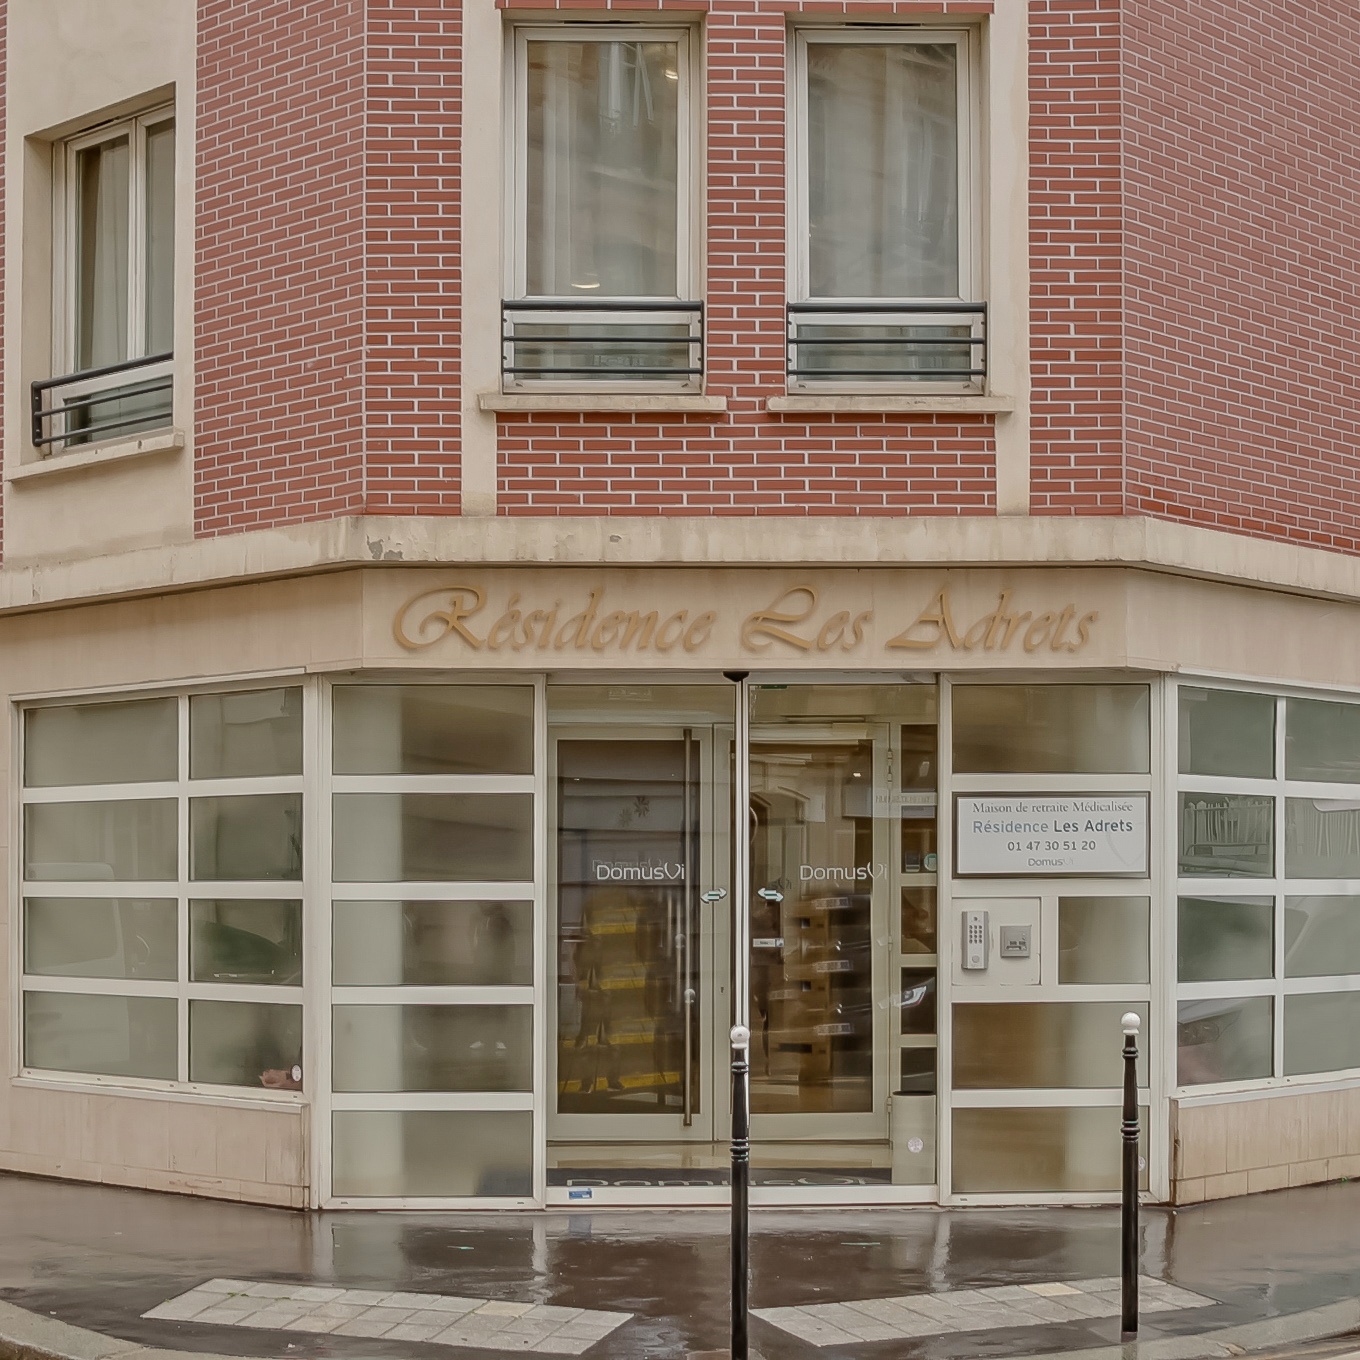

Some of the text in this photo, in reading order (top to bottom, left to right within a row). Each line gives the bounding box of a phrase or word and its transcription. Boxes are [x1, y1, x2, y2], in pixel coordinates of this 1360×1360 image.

[393, 584, 1099, 653] Résidence Les Adrets
[973, 801, 1133, 813] Maison de retraite Médicalisée
[973, 819, 1133, 833] Résidence Les Adrets
[1008, 841, 1096, 851] 01 47 30 51 20
[597, 862, 685, 880] DomusVi
[800, 862, 887, 880] DomusVi
